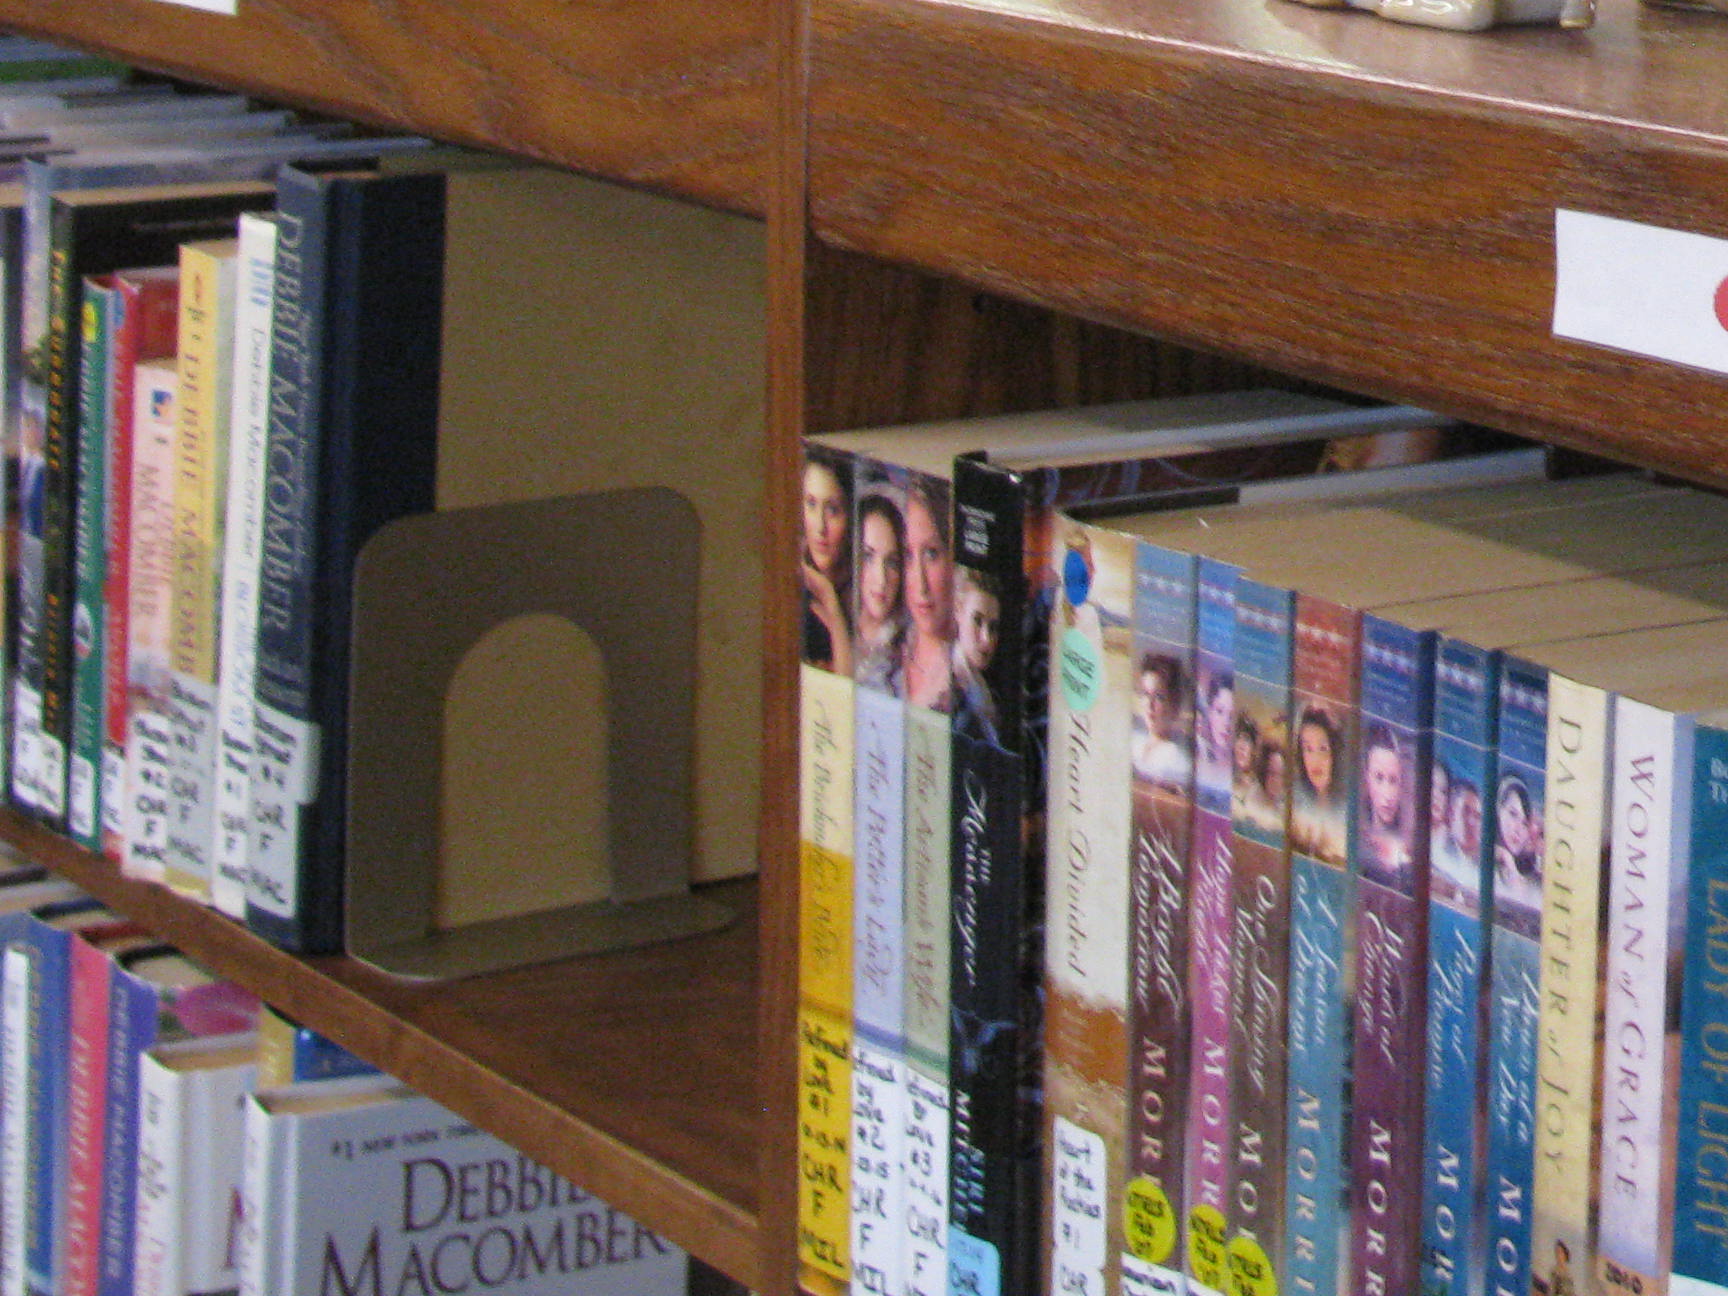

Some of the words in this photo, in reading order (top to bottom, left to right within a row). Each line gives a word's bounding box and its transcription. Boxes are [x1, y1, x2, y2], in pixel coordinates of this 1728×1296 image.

[270, 212, 303, 366] DEBBIE
[243, 423, 262, 559] Macomber
[262, 372, 299, 632] MACOMBER
[1066, 712, 1092, 814] Heart
[953, 768, 988, 988] Messenger
[1066, 829, 1092, 977] Divided
[1134, 829, 1158, 1013] Tomorrow
[1214, 830, 1234, 918] Hope
[1254, 874, 1276, 940] One
[1546, 715, 1583, 1015] DAUGHTER
[1623, 755, 1656, 959] WOMAN
[1150, 868, 1184, 1024] Bright
[1210, 932, 1232, 1014] Takes
[1292, 927, 1314, 1053] Dreams
[1313, 941, 1339, 1046] Season
[1359, 910, 1383, 1036] Change
[1379, 924, 1404, 1020] Winds
[1451, 927, 1476, 1016] Pages
[1620, 971, 1640, 1008] of
[1247, 942, 1281, 1094] Shining
[1430, 958, 1454, 1089] Promise
[1519, 970, 1540, 1074] Dawn
[1547, 1027, 1564, 1060] of
[1201, 1036, 1226, 1206] MORR
[1498, 1058, 1517, 1127] Day
[1541, 1073, 1568, 1176] JOY
[1613, 1020, 1648, 1201] GRACE
[319, 1206, 669, 1296] MACOMBER
[1293, 1089, 1320, 1293] MORRI
[1363, 1119, 1393, 1296] MORR
